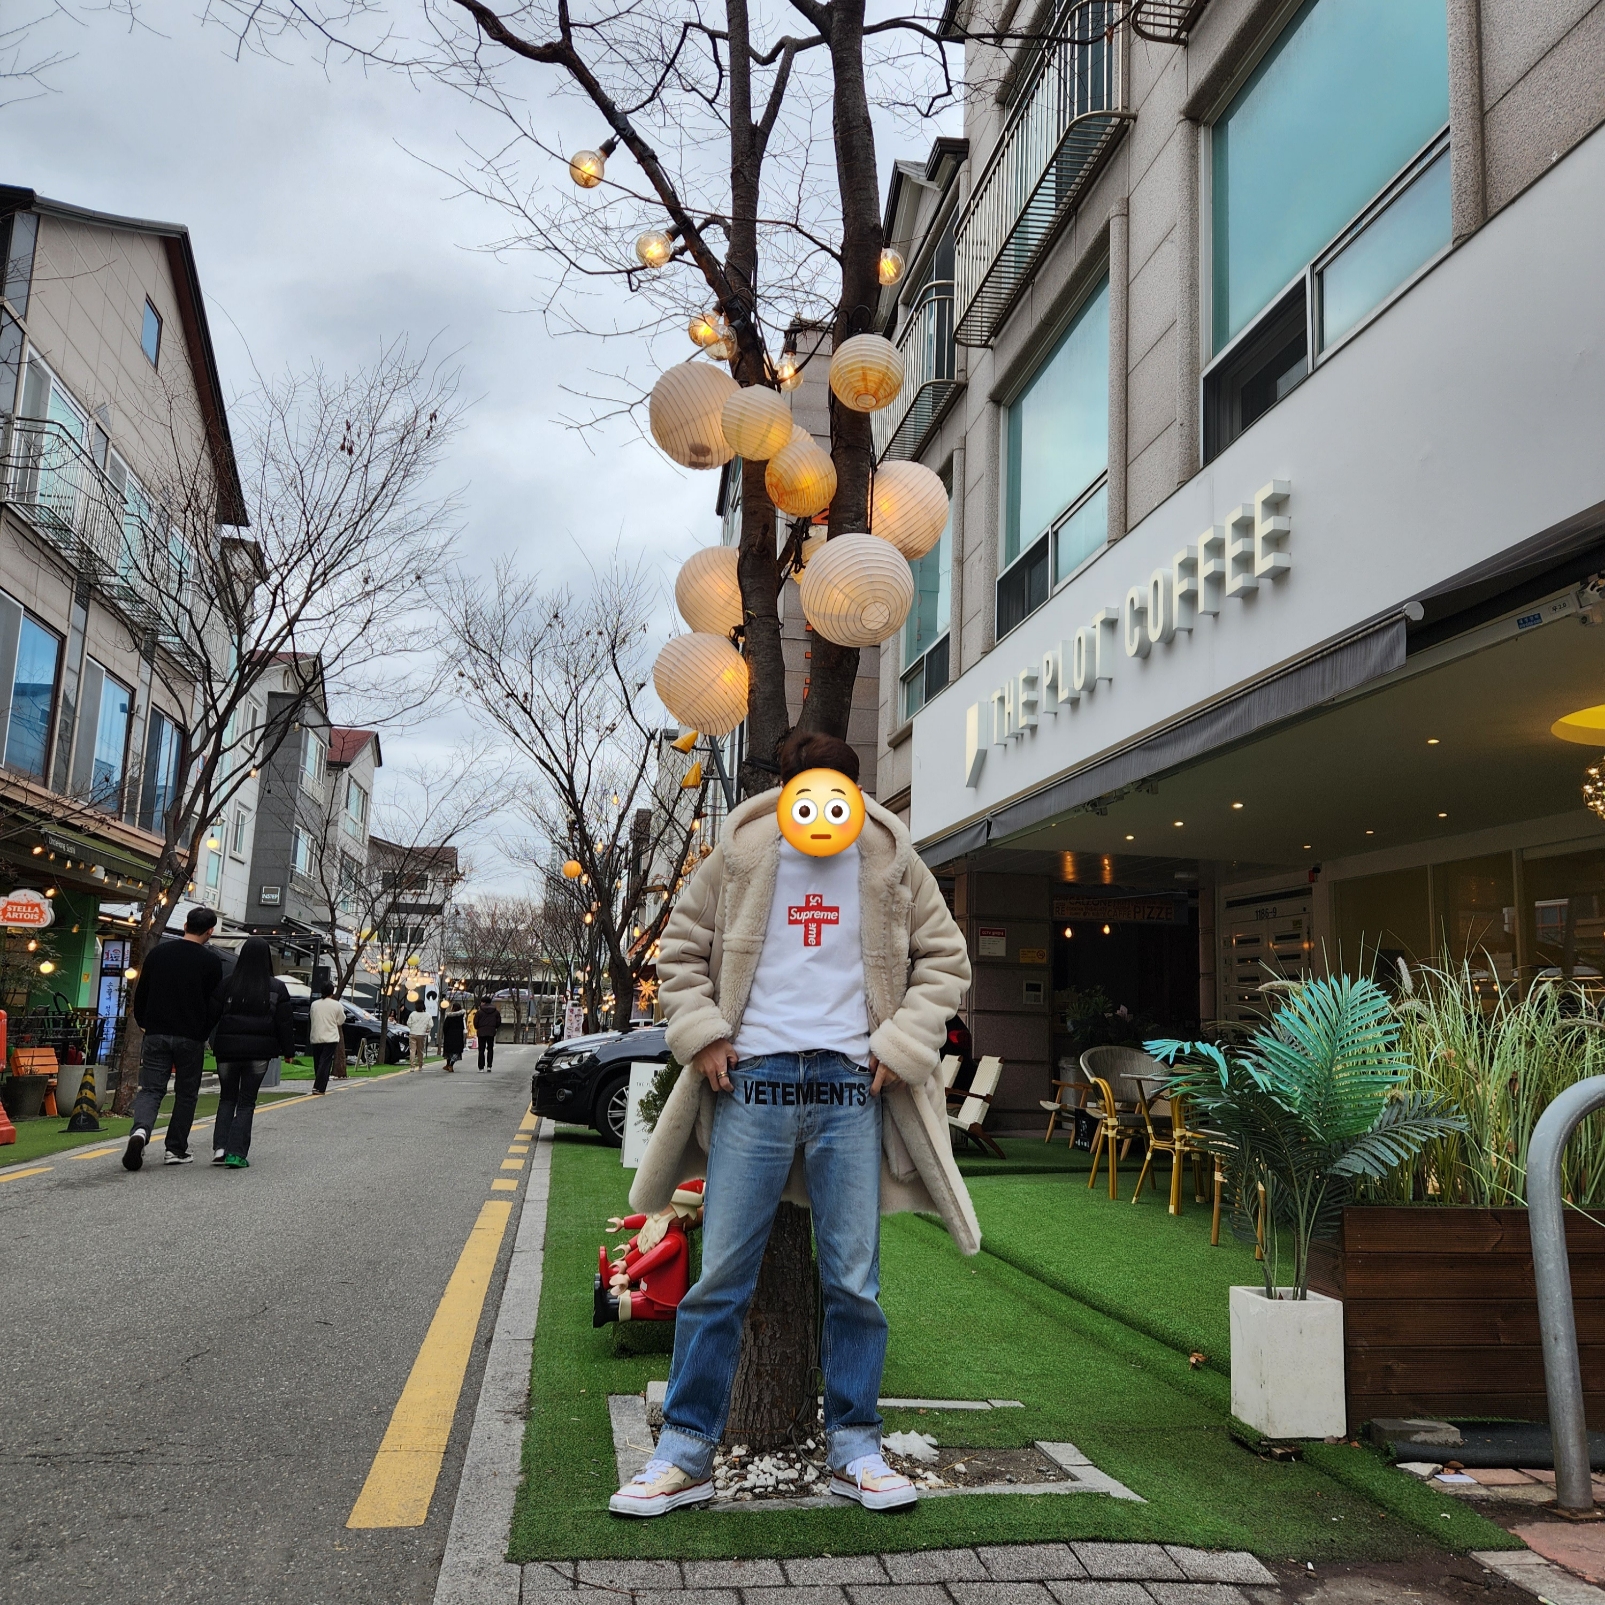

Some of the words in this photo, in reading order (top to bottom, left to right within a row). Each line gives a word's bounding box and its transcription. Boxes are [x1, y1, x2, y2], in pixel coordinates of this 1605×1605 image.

[991, 666, 1039, 746] THE
[1042, 606, 1120, 715] PLOT
[1124, 479, 1292, 659] COFFEE
[5, 911, 40, 920] ARTOIS
[6, 904, 40, 914] STELLA
[789, 907, 839, 923] Supreme
[1133, 905, 1173, 921] PIZZE
[1255, 906, 1277, 921] 1186-9
[743, 1080, 867, 1107] VETEMENTS
